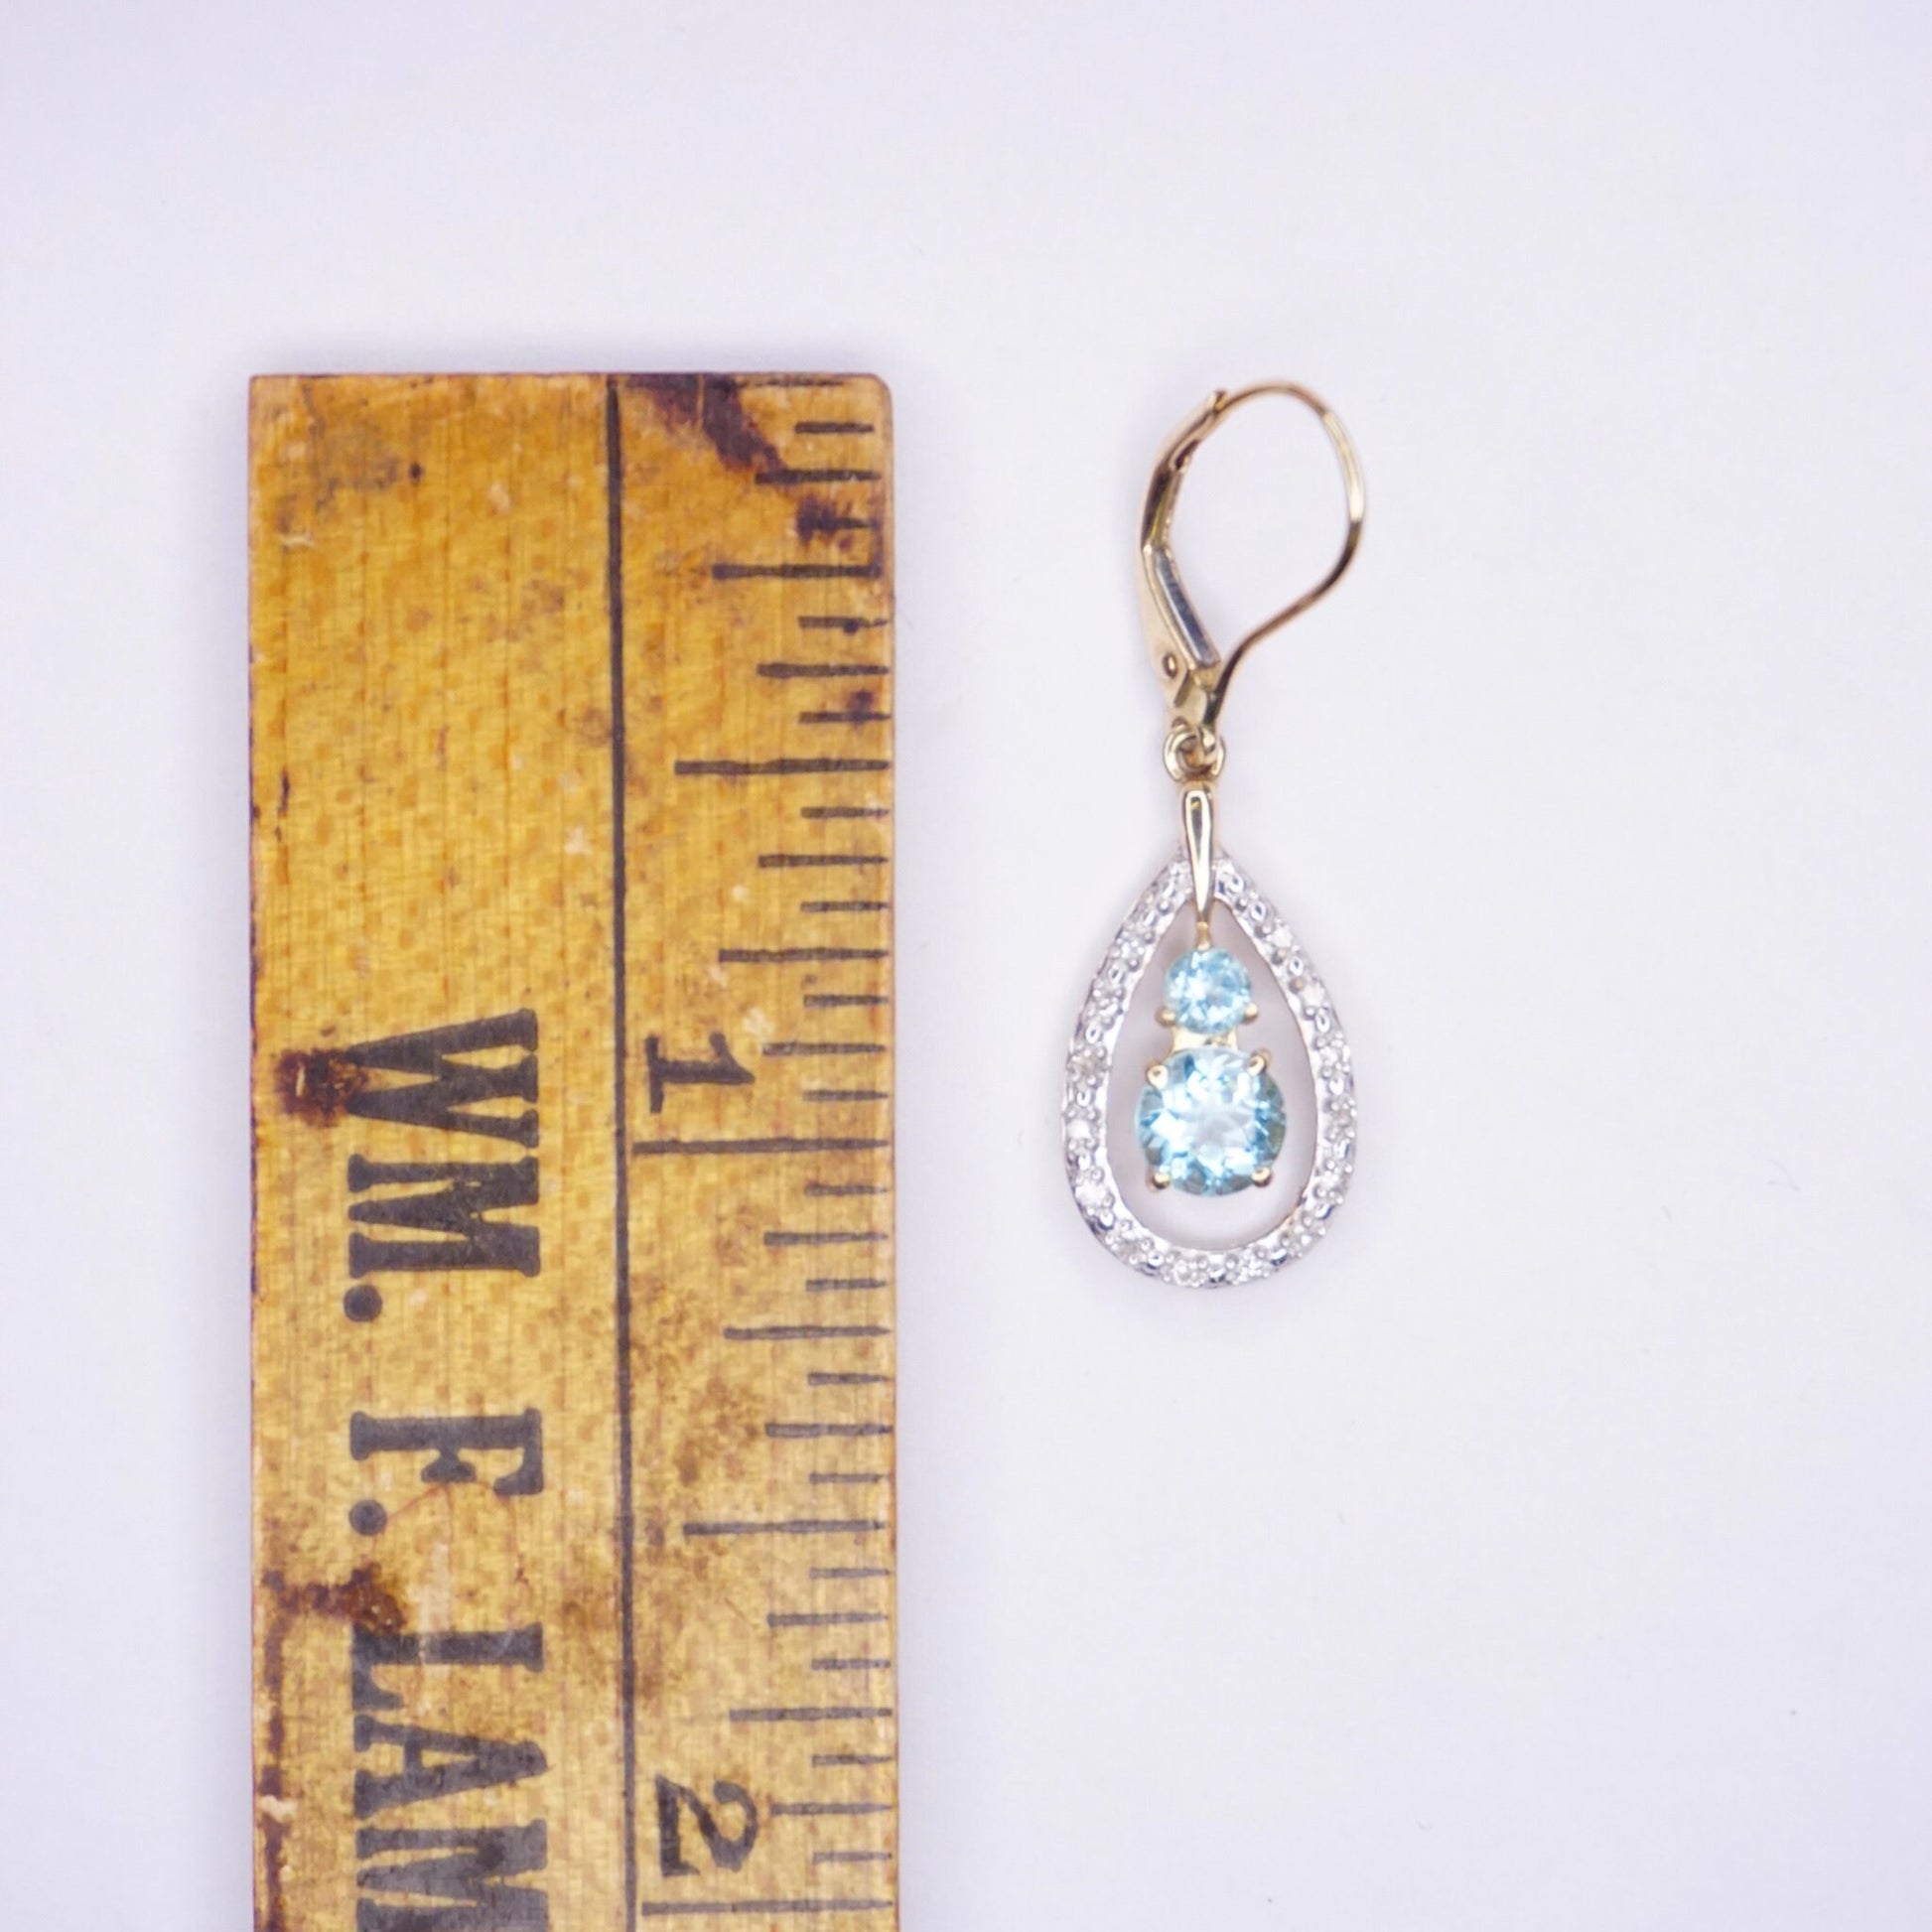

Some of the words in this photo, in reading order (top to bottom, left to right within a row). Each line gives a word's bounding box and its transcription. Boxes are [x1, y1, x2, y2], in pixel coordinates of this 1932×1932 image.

[644, 1034, 756, 1114] 1
[344, 1009, 540, 1323] WM.
[347, 1408, 544, 1537] F.
[655, 1775, 759, 1878] 2
